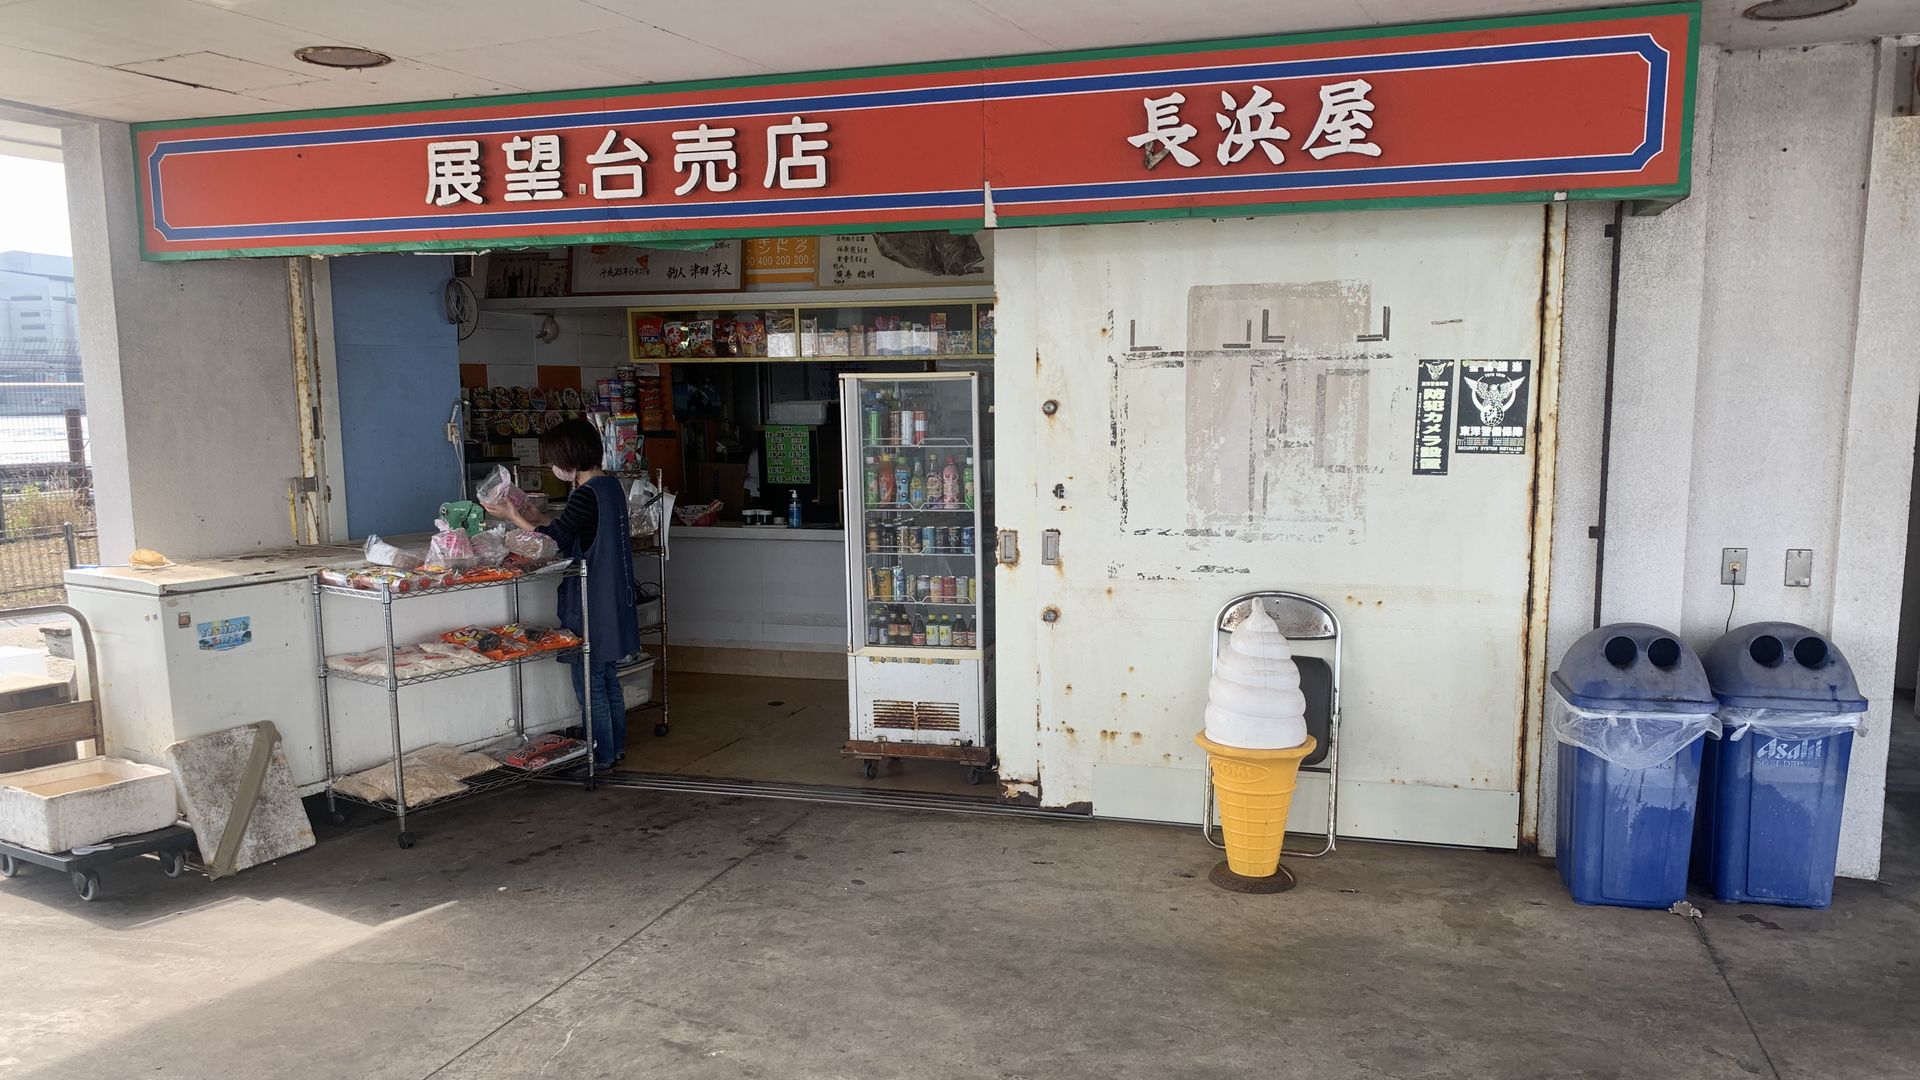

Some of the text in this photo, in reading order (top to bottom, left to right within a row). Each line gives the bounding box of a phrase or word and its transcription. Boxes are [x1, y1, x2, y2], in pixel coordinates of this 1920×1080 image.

[425, 78, 1382, 206] 展望台売店 長浜屋
[775, 255, 791, 265] 200
[793, 254, 809, 265] 200
[1420, 388, 1446, 469] 防犯カメラ設置
[1757, 738, 1823, 760] Asahi
